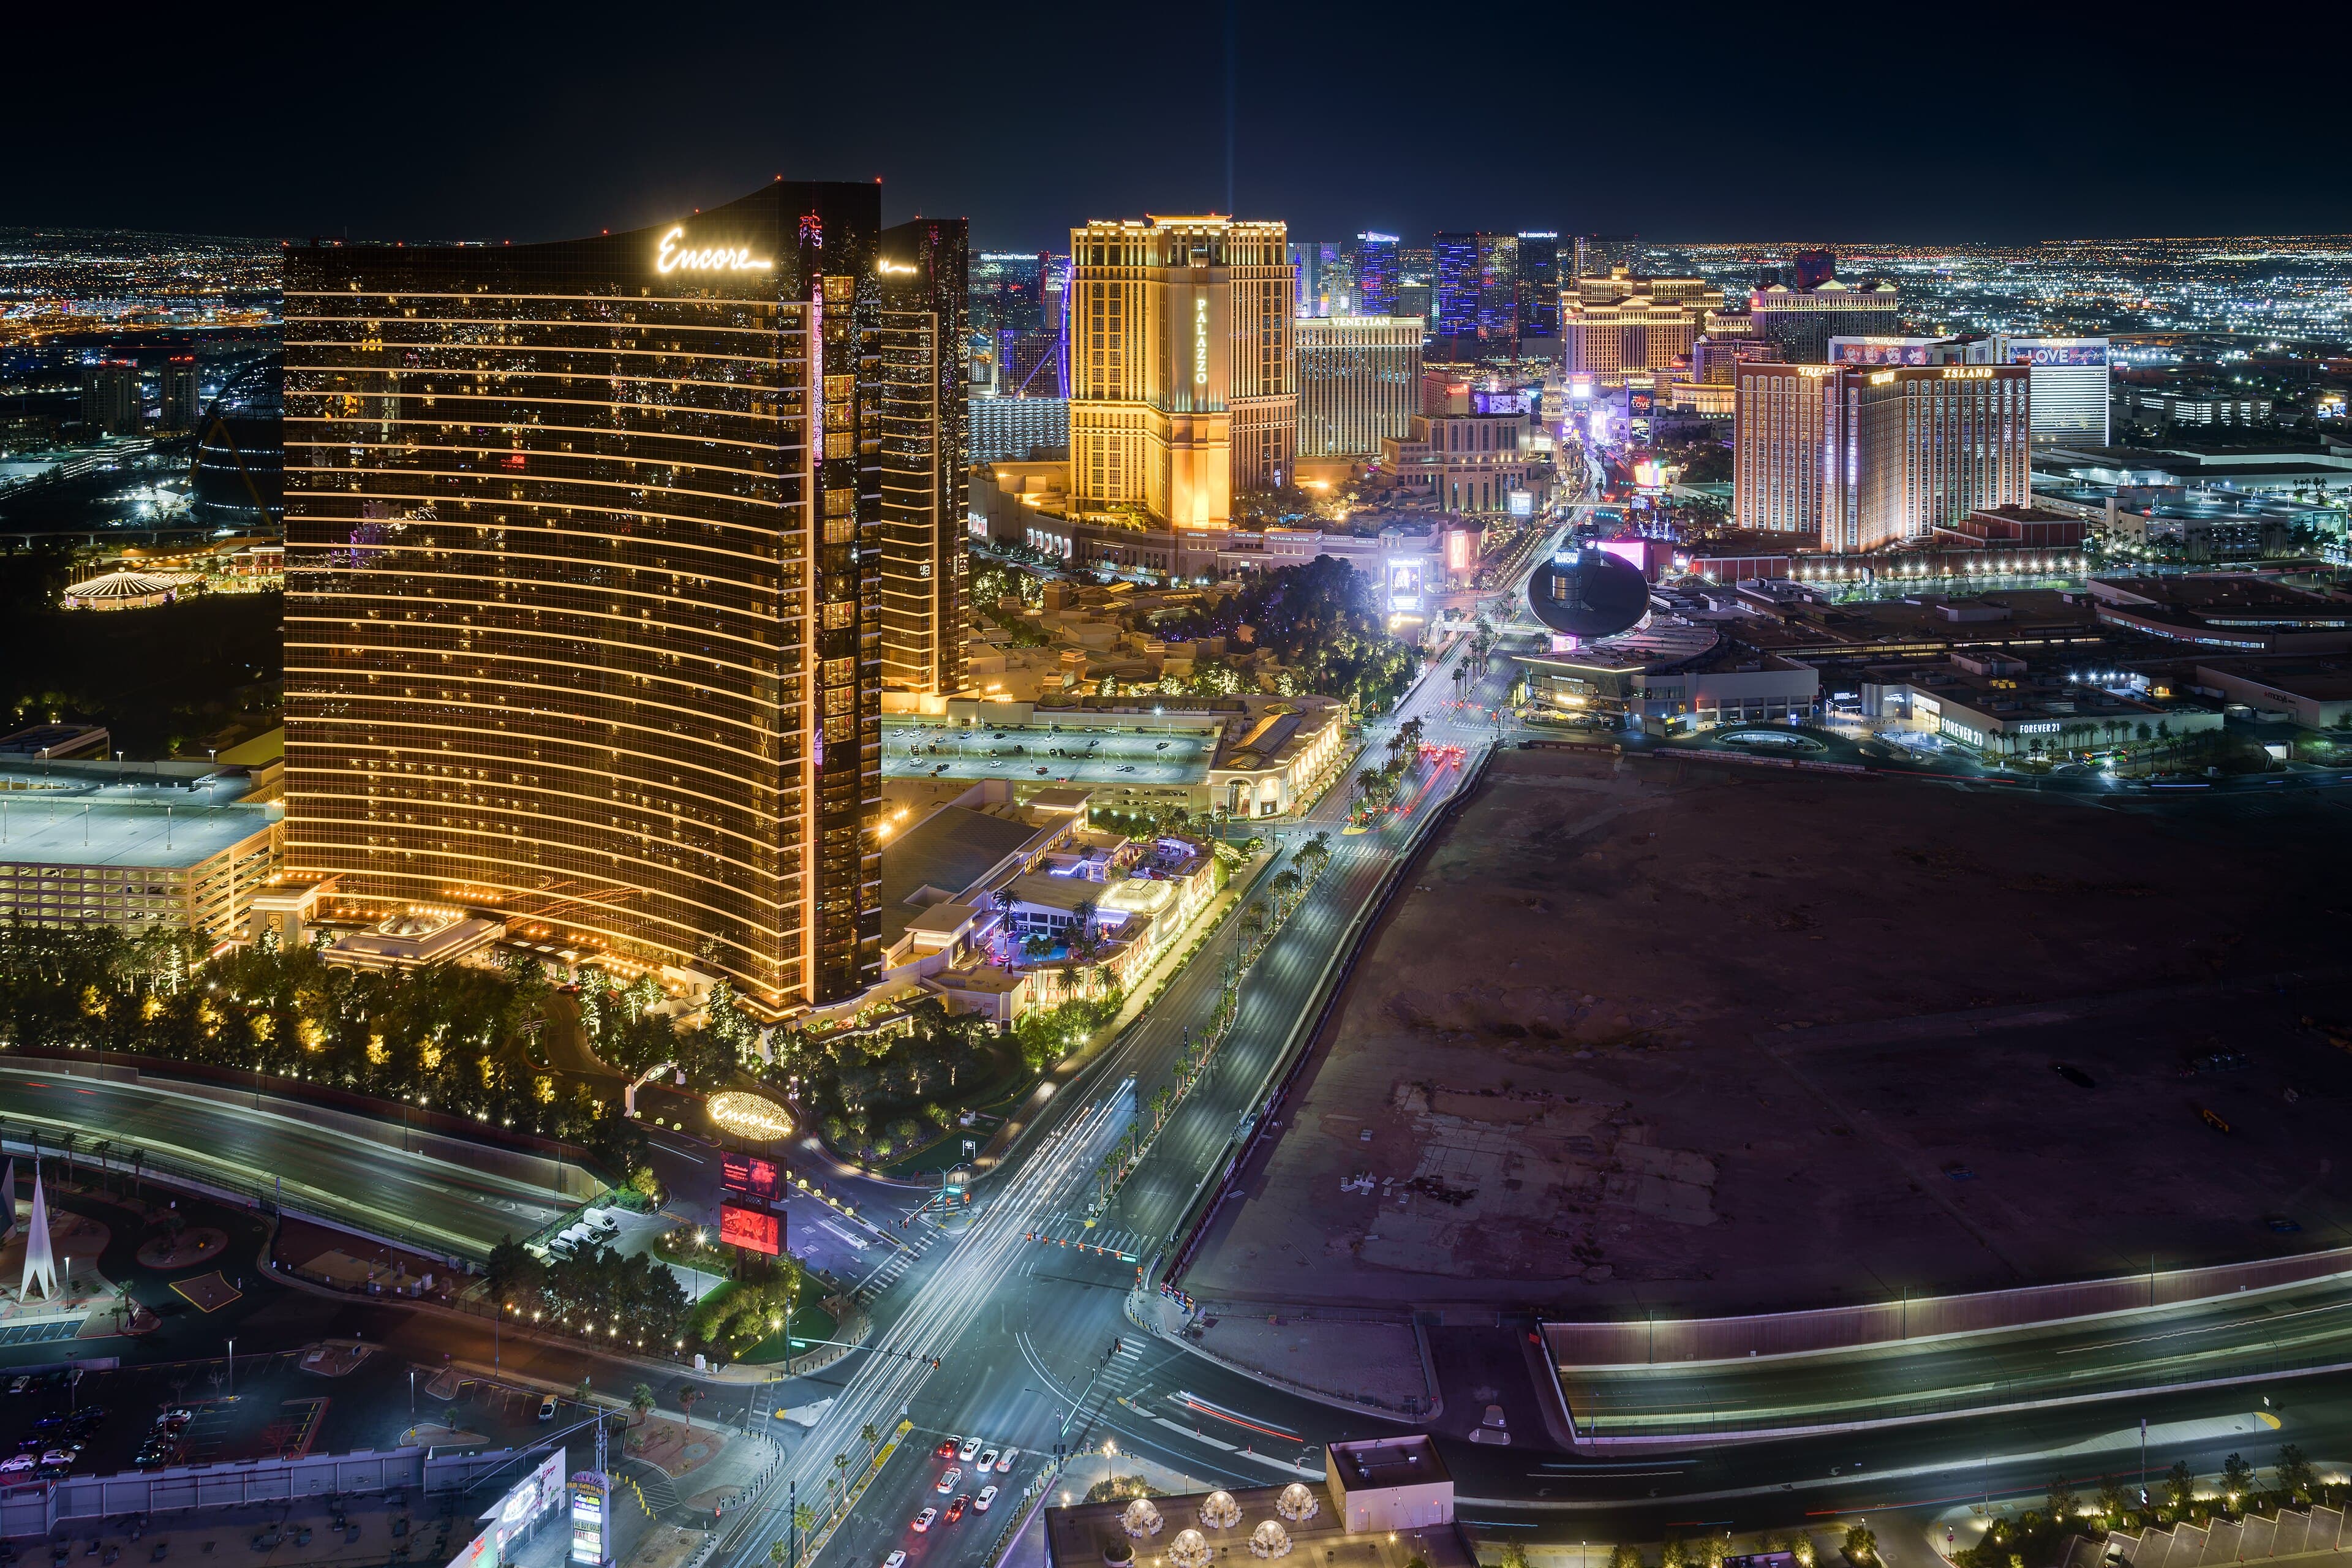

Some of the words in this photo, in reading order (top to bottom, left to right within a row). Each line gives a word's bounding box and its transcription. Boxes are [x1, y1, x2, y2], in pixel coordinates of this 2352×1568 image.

[658, 227, 772, 273] Encore
[1332, 317, 1390, 326] VENETIAN
[1196, 299, 1207, 384] PALAZZO
[2028, 349, 2068, 363] LOVE
[1943, 369, 1992, 378] ISLAND
[1942, 718, 1972, 742] FOREVER
[1973, 732, 1984, 746] 21
[2019, 724, 2051, 734] FOREVER
[2051, 723, 2060, 732] 21
[711, 1097, 791, 1133] Encore
[581, 1503, 600, 1512] Budget
[575, 1530, 599, 1542] TATTOO
